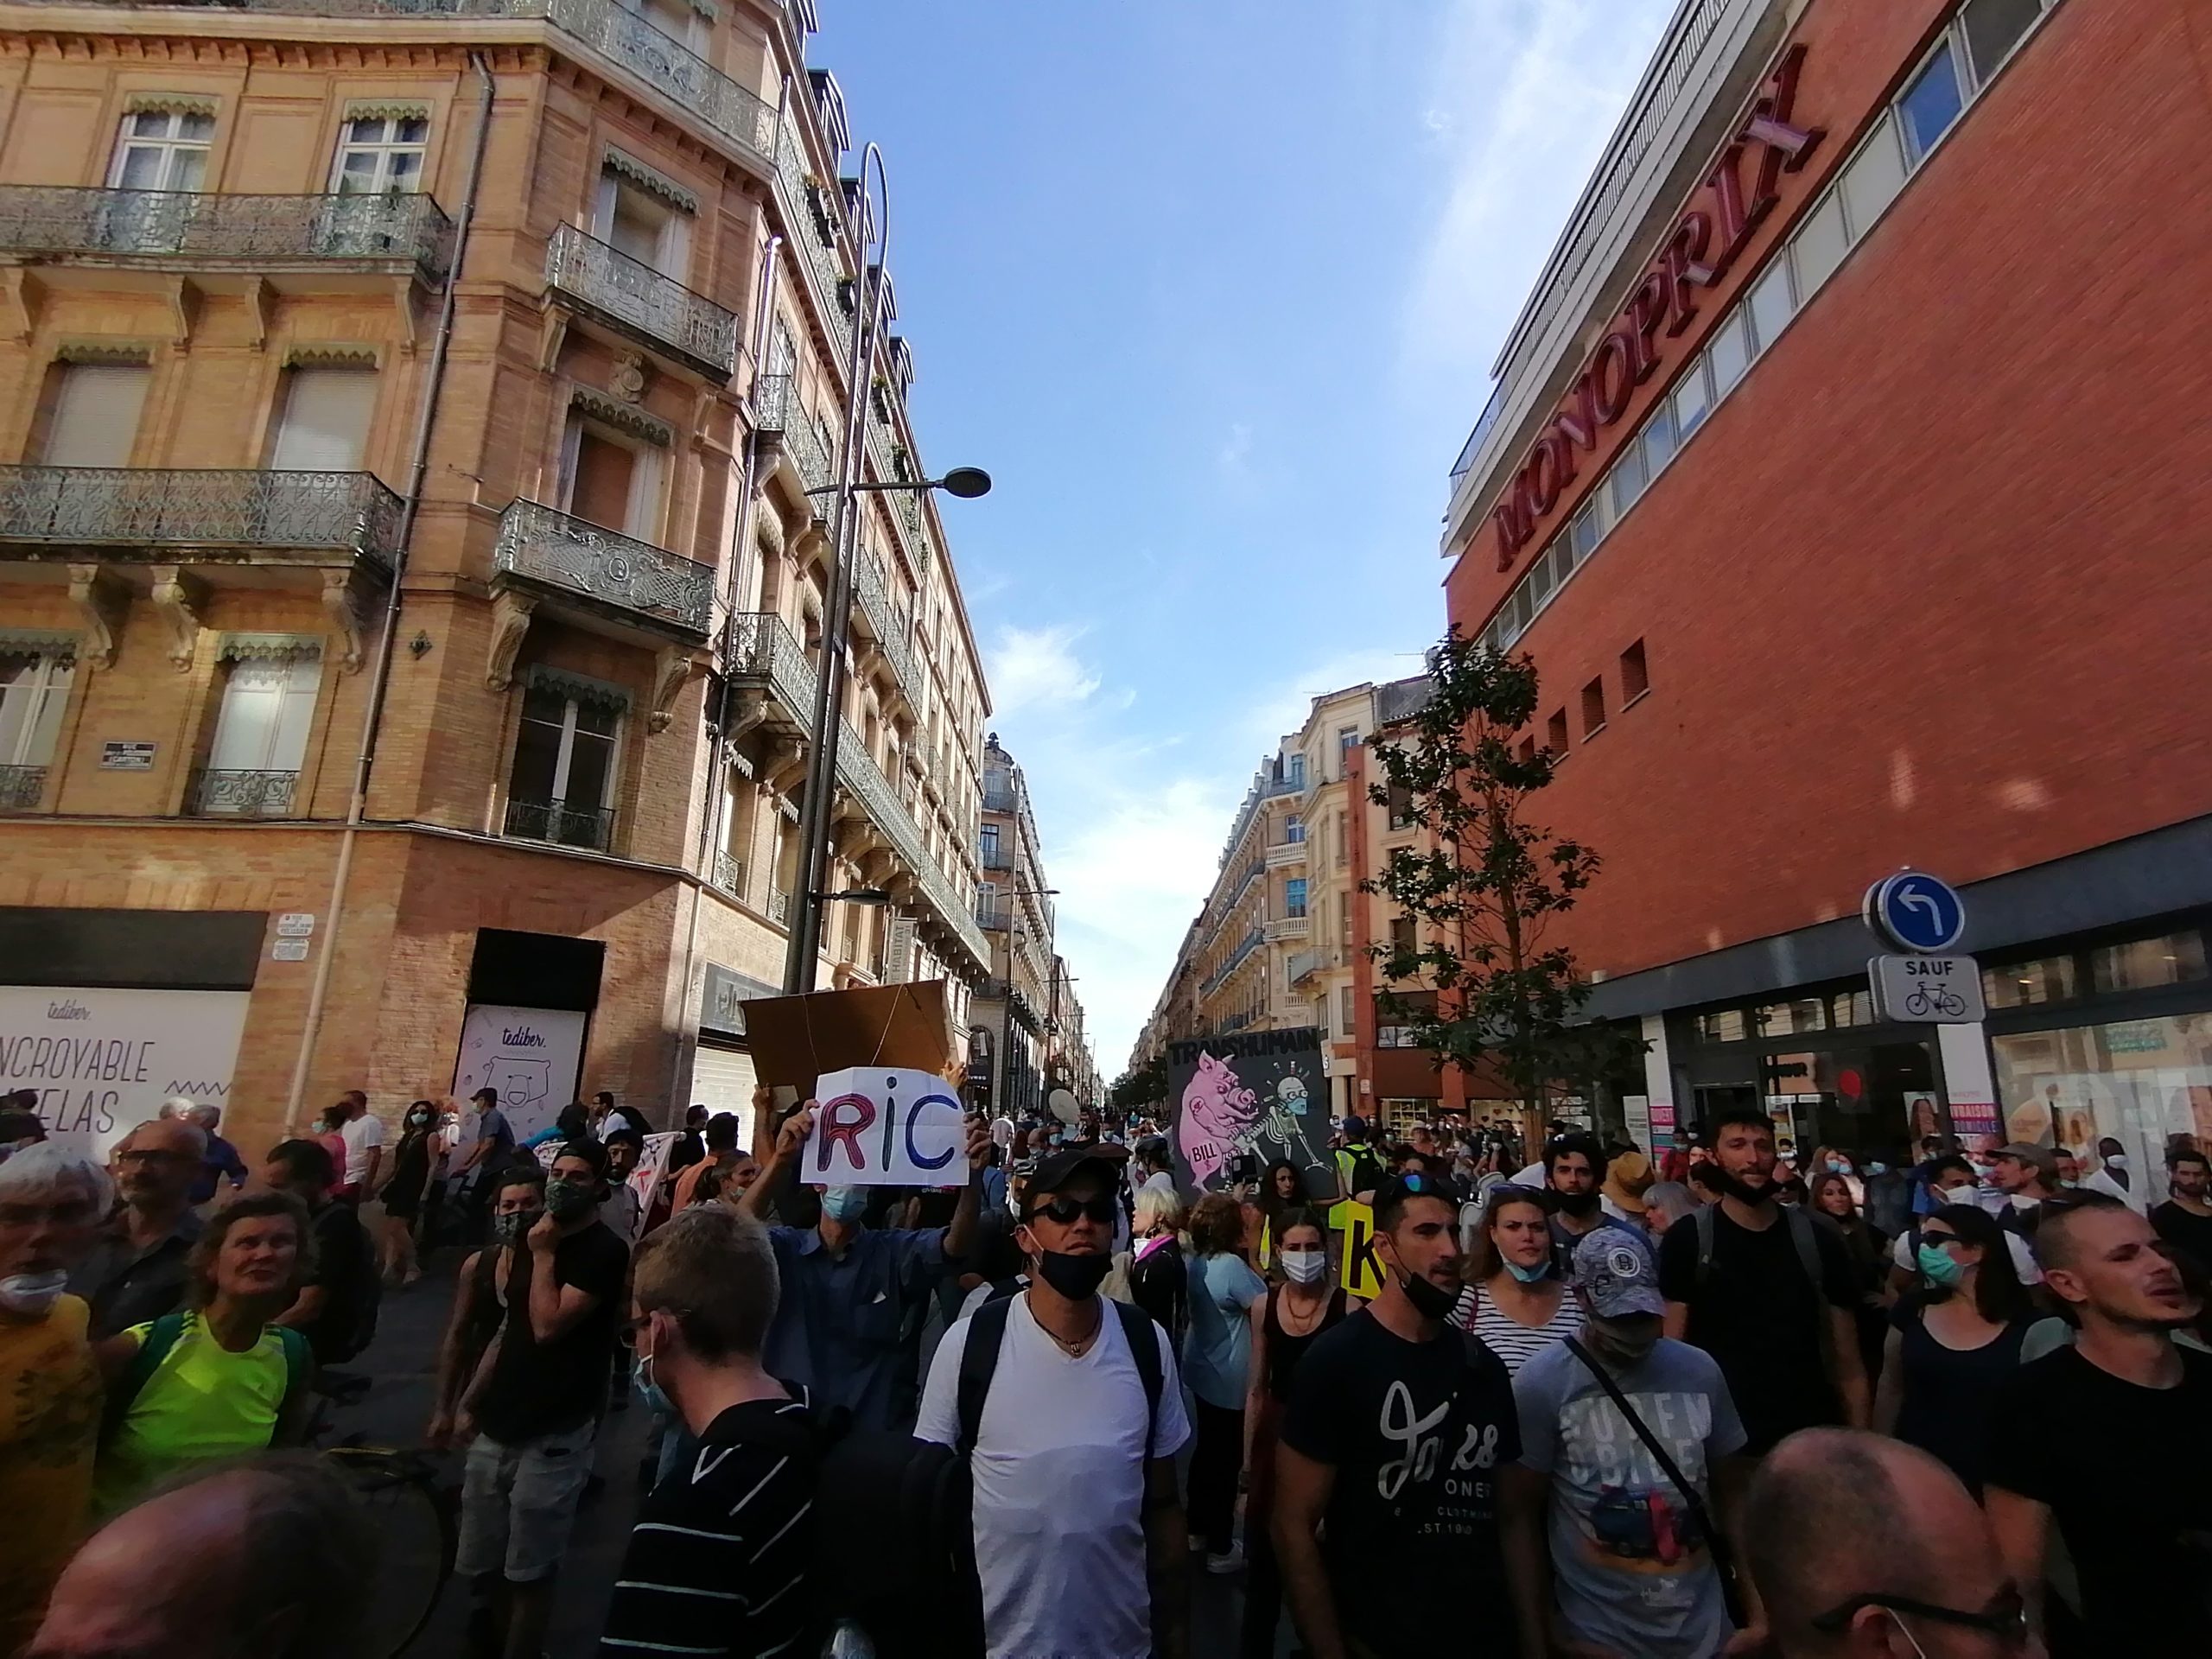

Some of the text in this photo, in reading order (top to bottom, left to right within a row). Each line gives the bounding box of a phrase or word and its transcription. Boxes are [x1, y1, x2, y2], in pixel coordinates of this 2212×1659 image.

[1496, 43, 1827, 572] MONOPRIX
[893, 925, 904, 972] HABITAT
[1906, 961, 1953, 976] SAUF
[1192, 1142, 1217, 1162] BILL
